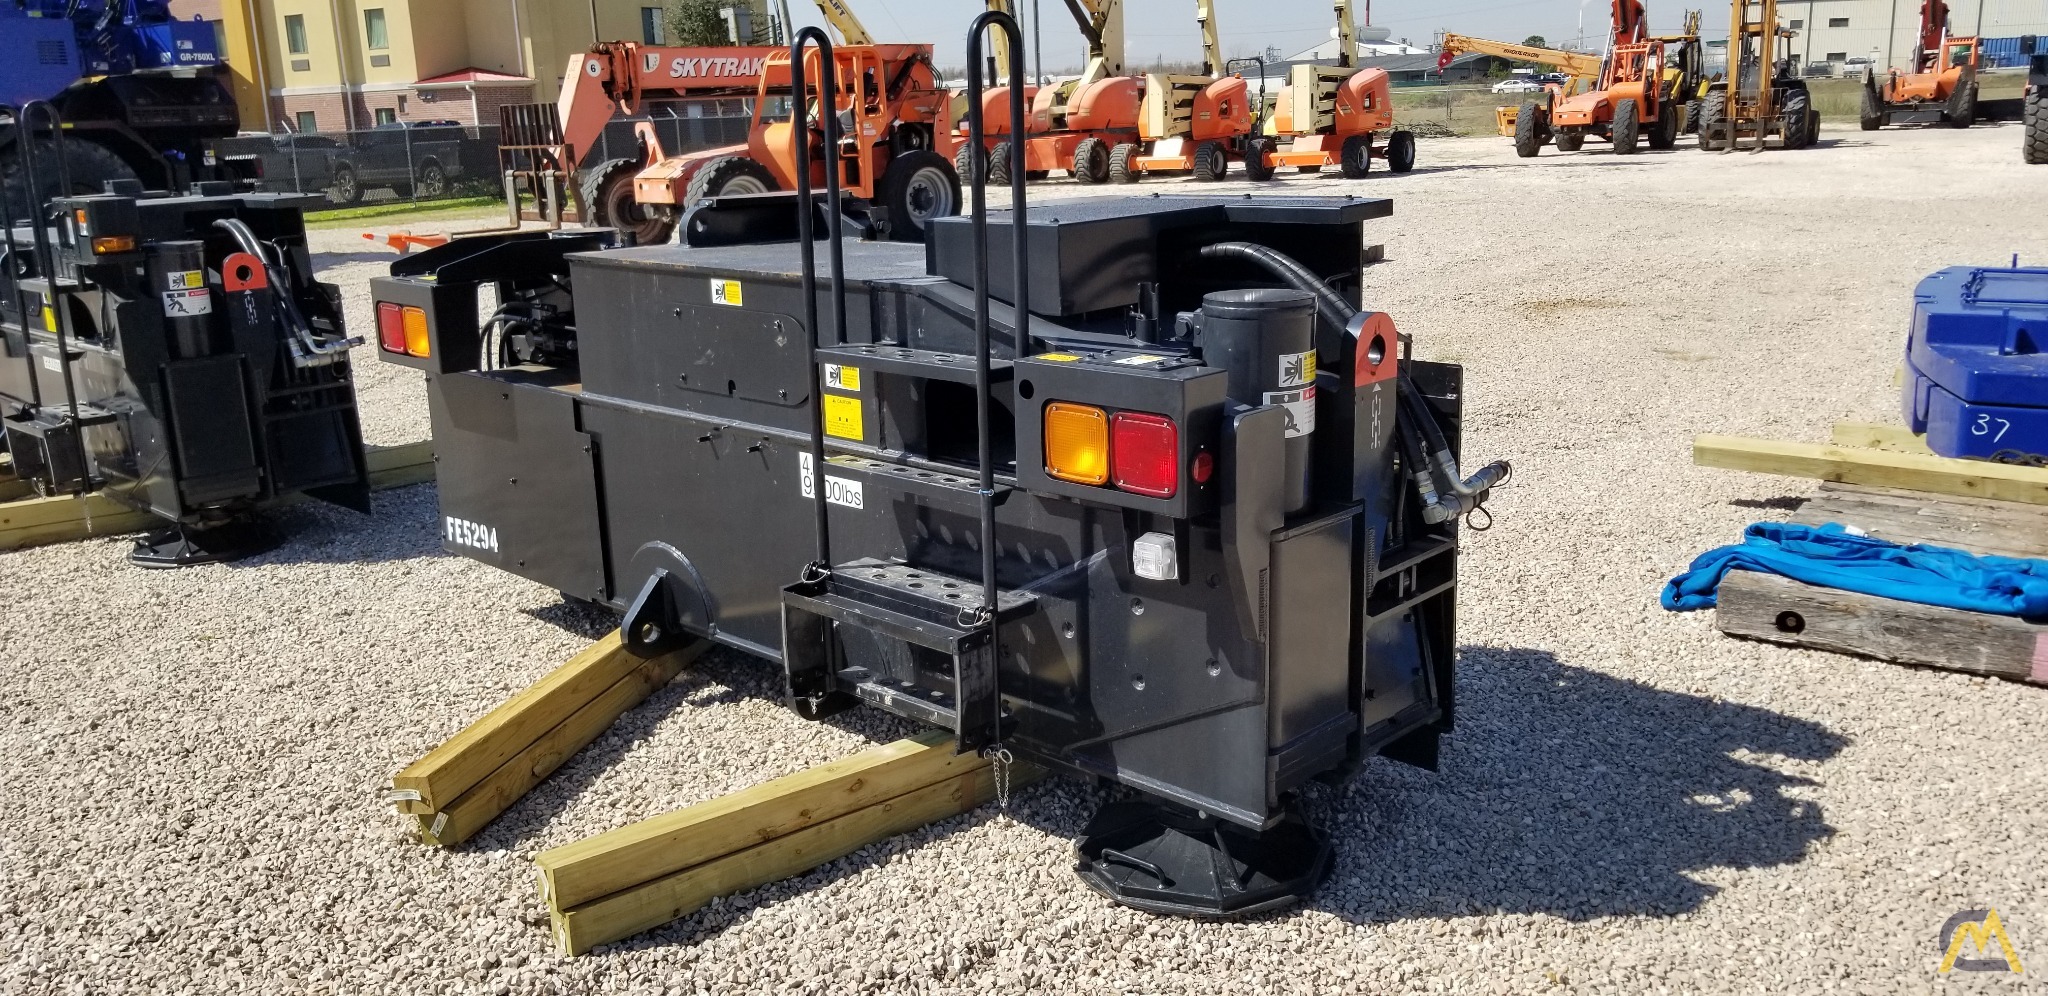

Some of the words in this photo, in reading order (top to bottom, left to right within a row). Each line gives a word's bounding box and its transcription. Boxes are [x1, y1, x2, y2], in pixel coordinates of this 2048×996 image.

[590, 63, 597, 73] 6
[670, 57, 766, 78] SKYTRAK
[1971, 413, 2010, 444] 37
[446, 515, 499, 553] FE5294
